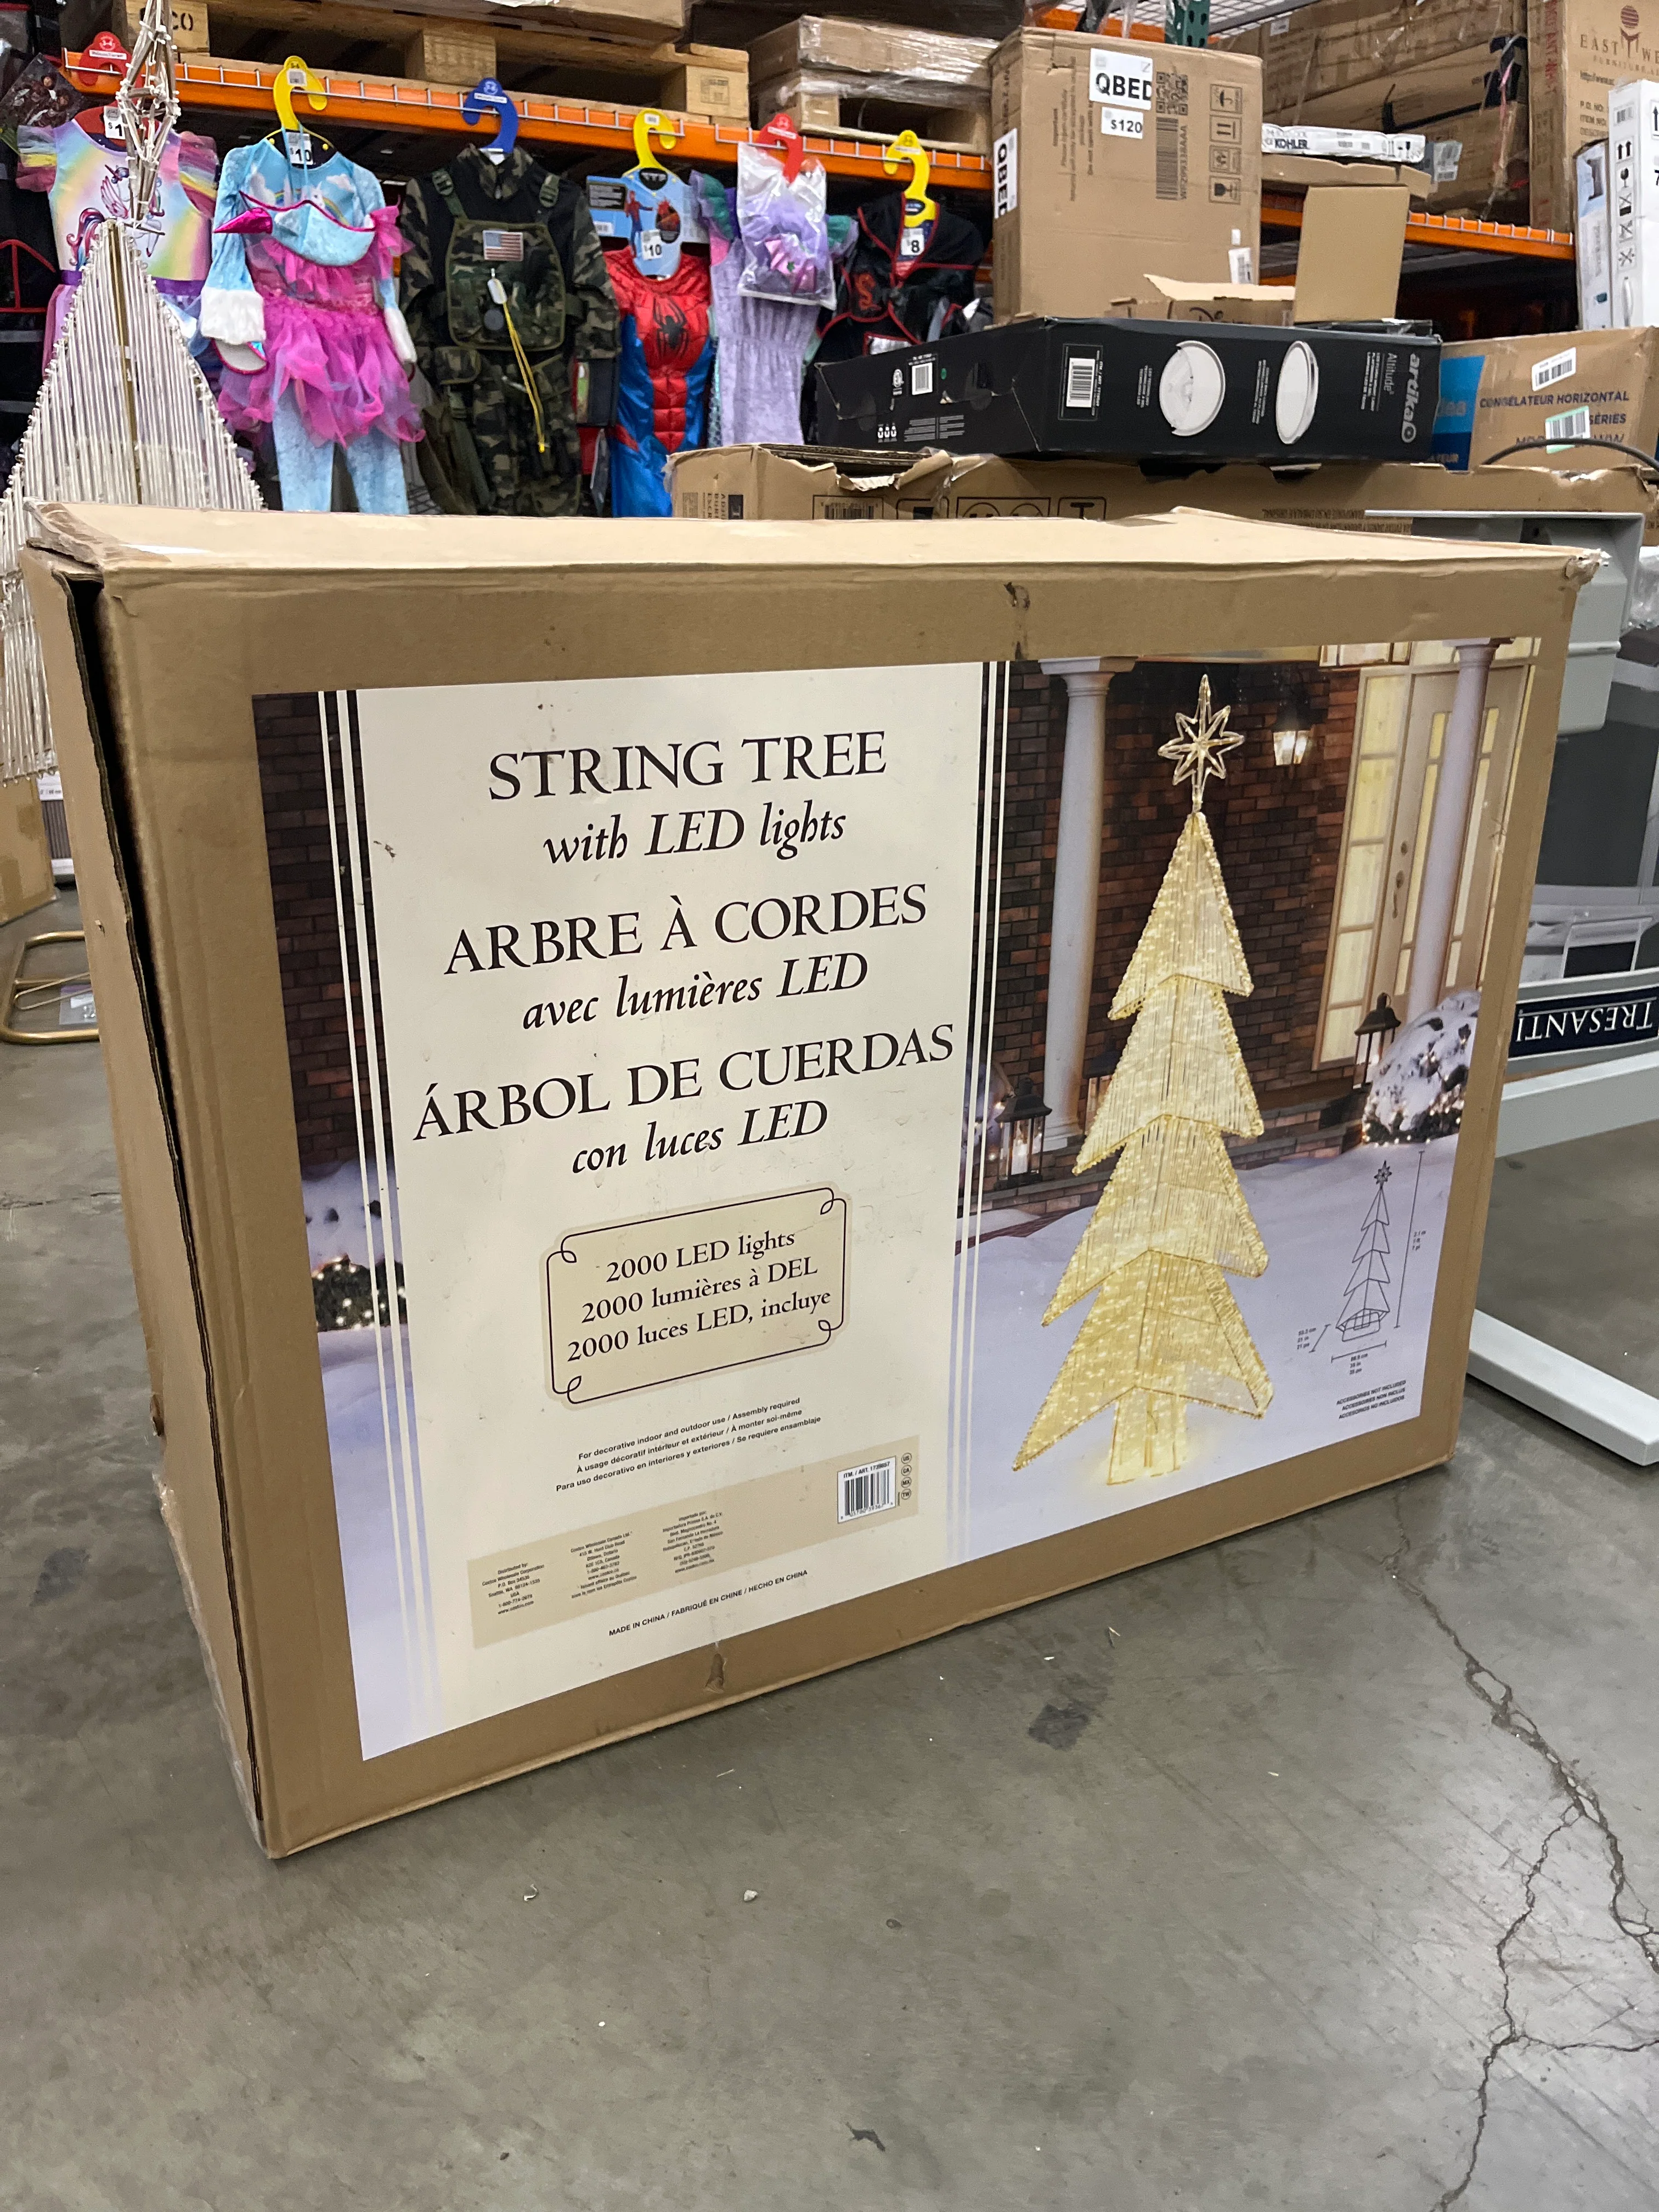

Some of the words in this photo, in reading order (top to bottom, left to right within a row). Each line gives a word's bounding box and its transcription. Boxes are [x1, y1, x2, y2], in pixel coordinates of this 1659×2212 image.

[1581, 34, 1618, 55] EAST
[1096, 72, 1152, 101] QBED
[1111, 119, 1143, 133] $120
[1274, 138, 1308, 150] KOHLER
[1404, 353, 1420, 422] artika
[1557, 391, 1629, 404] HORIZONTAL
[489, 741, 723, 800] STRING
[741, 731, 886, 783] TREE
[543, 814, 627, 864] with
[644, 809, 744, 855] LED
[760, 799, 846, 860] lights
[443, 912, 642, 974] ARBRE
[659, 895, 697, 950] À
[715, 883, 926, 943] CORDES
[523, 997, 599, 1029] avec
[616, 971, 762, 1017] lumières
[776, 952, 867, 997] LED
[1516, 1002, 1654, 1042] TRESANTI
[413, 1073, 610, 1141] ÁRBOL
[627, 1058, 702, 1106] DE
[719, 1024, 953, 1090] CUERDAS
[572, 1143, 627, 1173] con
[645, 1121, 724, 1161] luces
[737, 1101, 827, 1146] LED
[606, 1252, 667, 1282] 2000
[676, 1240, 729, 1268] LED
[738, 1230, 794, 1257] lights
[582, 1292, 642, 1323] 2000
[651, 1278, 741, 1308] lumières
[749, 1268, 760, 1287] à
[768, 1256, 817, 1283] DEL
[567, 1330, 628, 1362] 2000
[637, 1323, 688, 1345] luces
[697, 1304, 753, 1331] LED,
[761, 1291, 831, 1318] incluye
[1381, 1380, 1406, 1390] INCLUDED
[1388, 1387, 1405, 1396] INCLUS
[556, 1482, 574, 1492] Para
[593, 1466, 635, 1481] decorativo
[648, 1452, 684, 1466] interiores
[692, 1440, 730, 1454] exteriores
[748, 1427, 778, 1440] requiere
[780, 1417, 821, 1431] ensamblaje
[578, 1452, 592, 1460] For
[594, 1441, 635, 1456] decorative
[637, 1434, 662, 1444] indoor
[664, 1428, 678, 1437] and
[680, 1421, 710, 1433] outdoor
[732, 1406, 768, 1420] Assembly
[770, 1397, 800, 1410] required
[584, 1460, 608, 1471] usage
[611, 1449, 645, 1464] décoratif
[647, 1441, 680, 1454] intérieur
[691, 1430, 724, 1442] extérieur
[738, 1419, 764, 1430] monter
[766, 1410, 802, 1423] soi-même
[609, 1624, 630, 1636] MADE
[642, 1613, 665, 1625] CHINA
[672, 1599, 707, 1616] FABRIQUÉ
[709, 1596, 719, 1605] EN
[720, 1589, 742, 1601] CHINE
[748, 1580, 773, 1592] HECHO
[786, 1570, 807, 1581] CHINA
